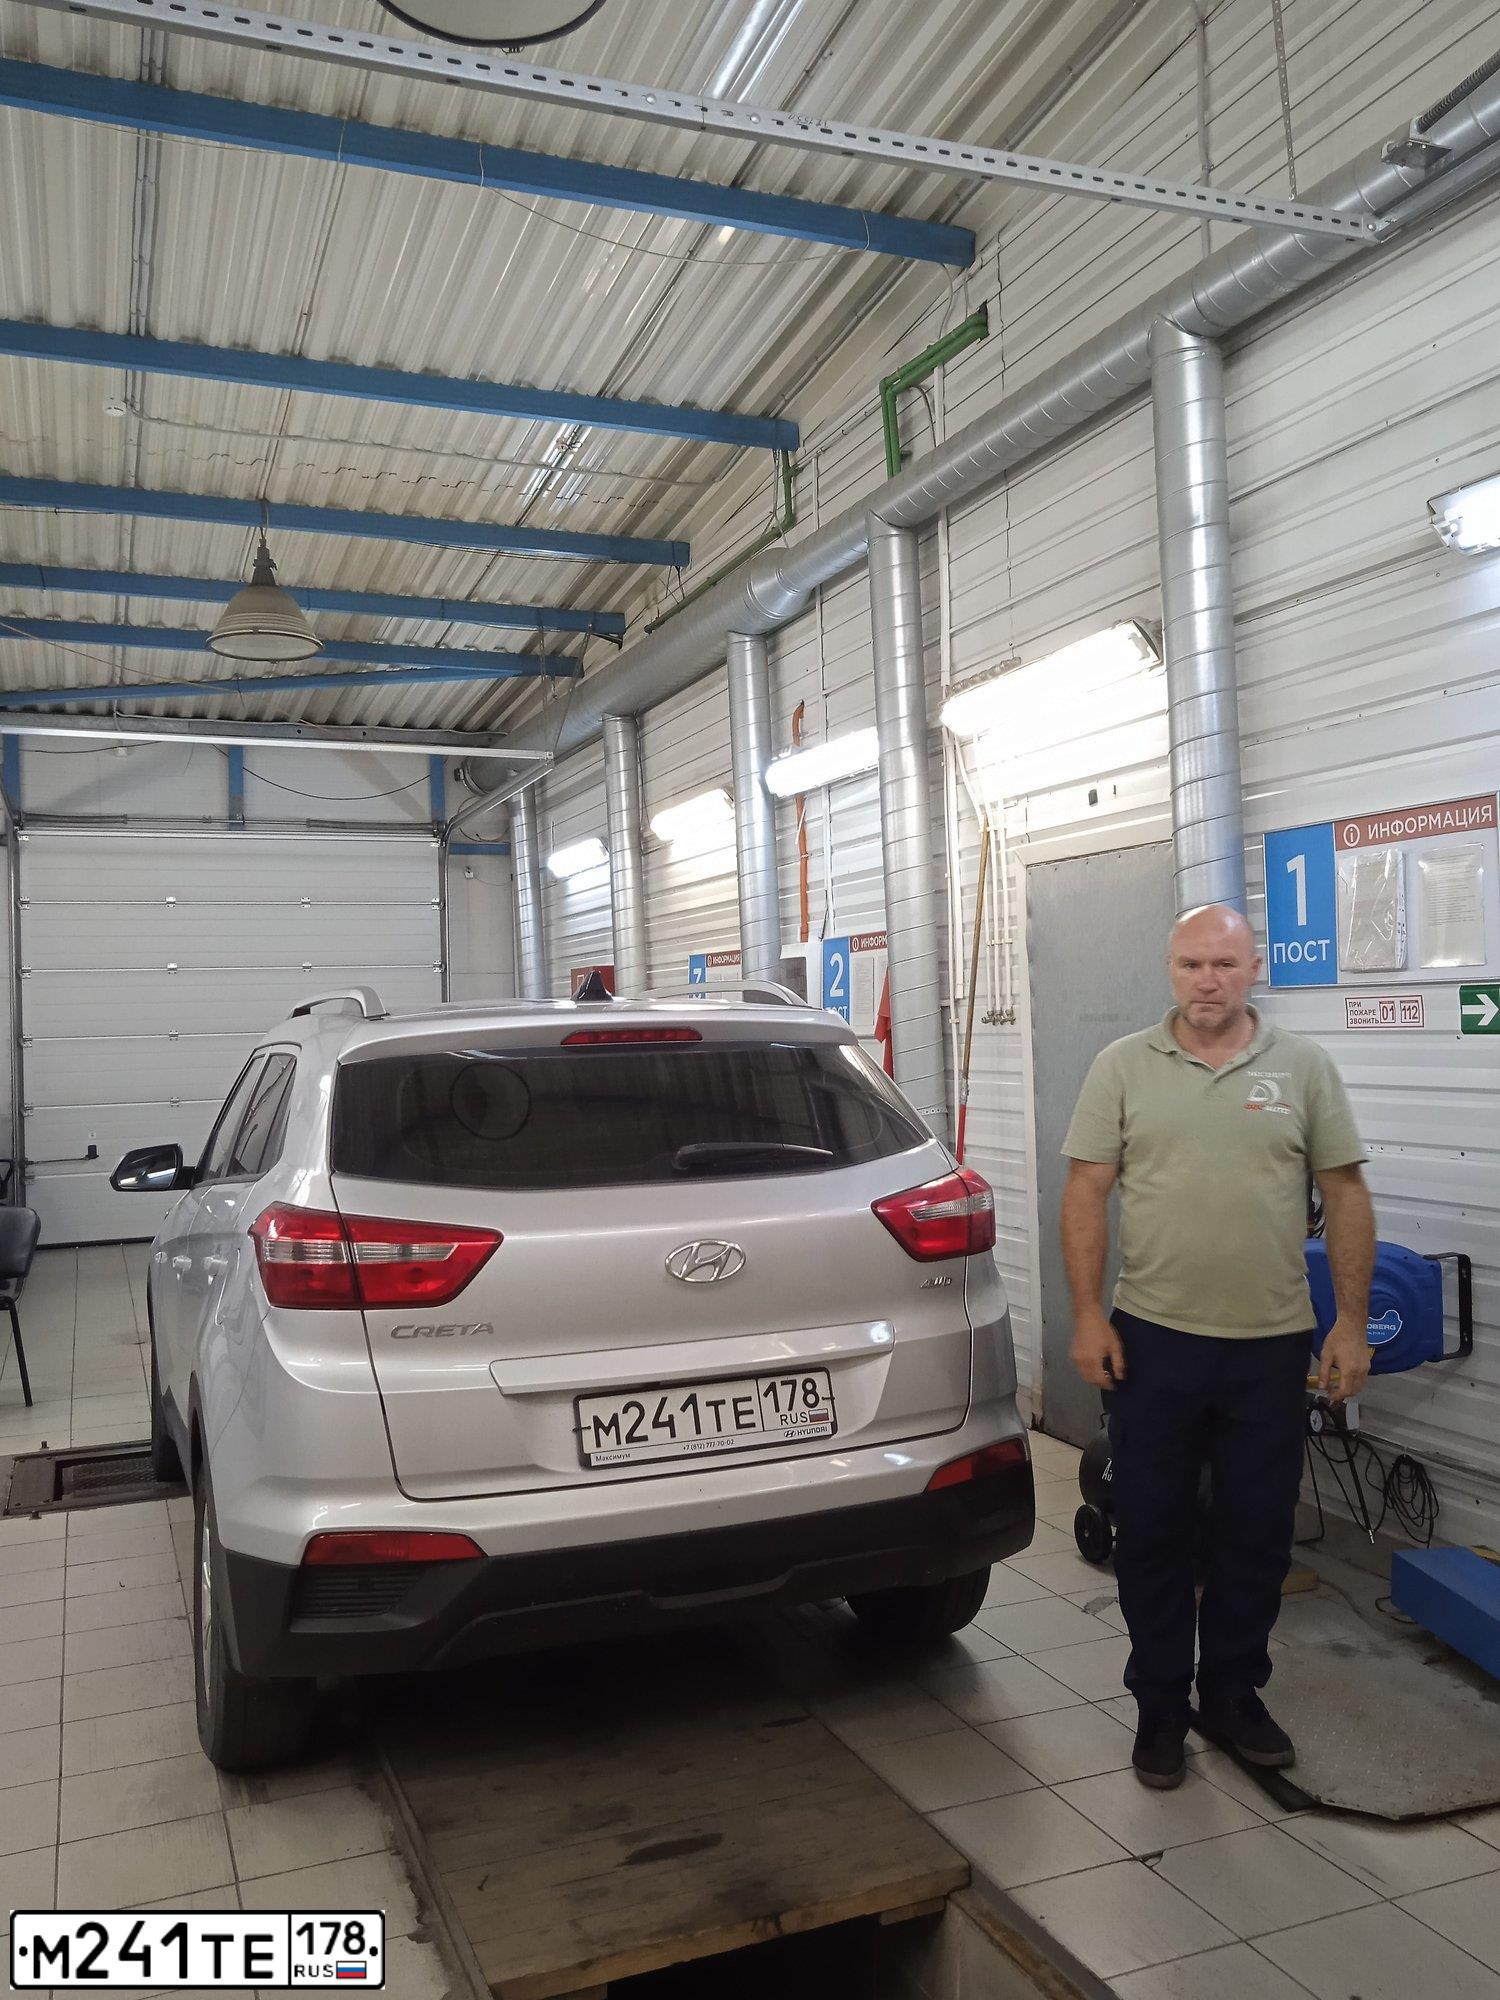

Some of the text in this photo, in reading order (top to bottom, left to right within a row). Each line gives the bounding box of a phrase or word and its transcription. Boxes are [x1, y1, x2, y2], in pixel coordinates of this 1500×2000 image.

[1368, 805, 1492, 840] ИНФОРМАЦИЯ
[1286, 854, 1307, 926] 1
[1273, 940, 1331, 964] ПОСТ
[829, 952, 844, 998] 2
[1349, 1017, 1380, 1025] ЗВОНИТЬ
[1381, 1005, 1419, 1020] 01 112
[390, 1322, 494, 1339] CRETA
[592, 1377, 820, 1448] М241ТЕ 178
[779, 1412, 808, 1425] RUS
[797, 1426, 828, 1435] HYUNDAI
[595, 1453, 631, 1462] Максимум
